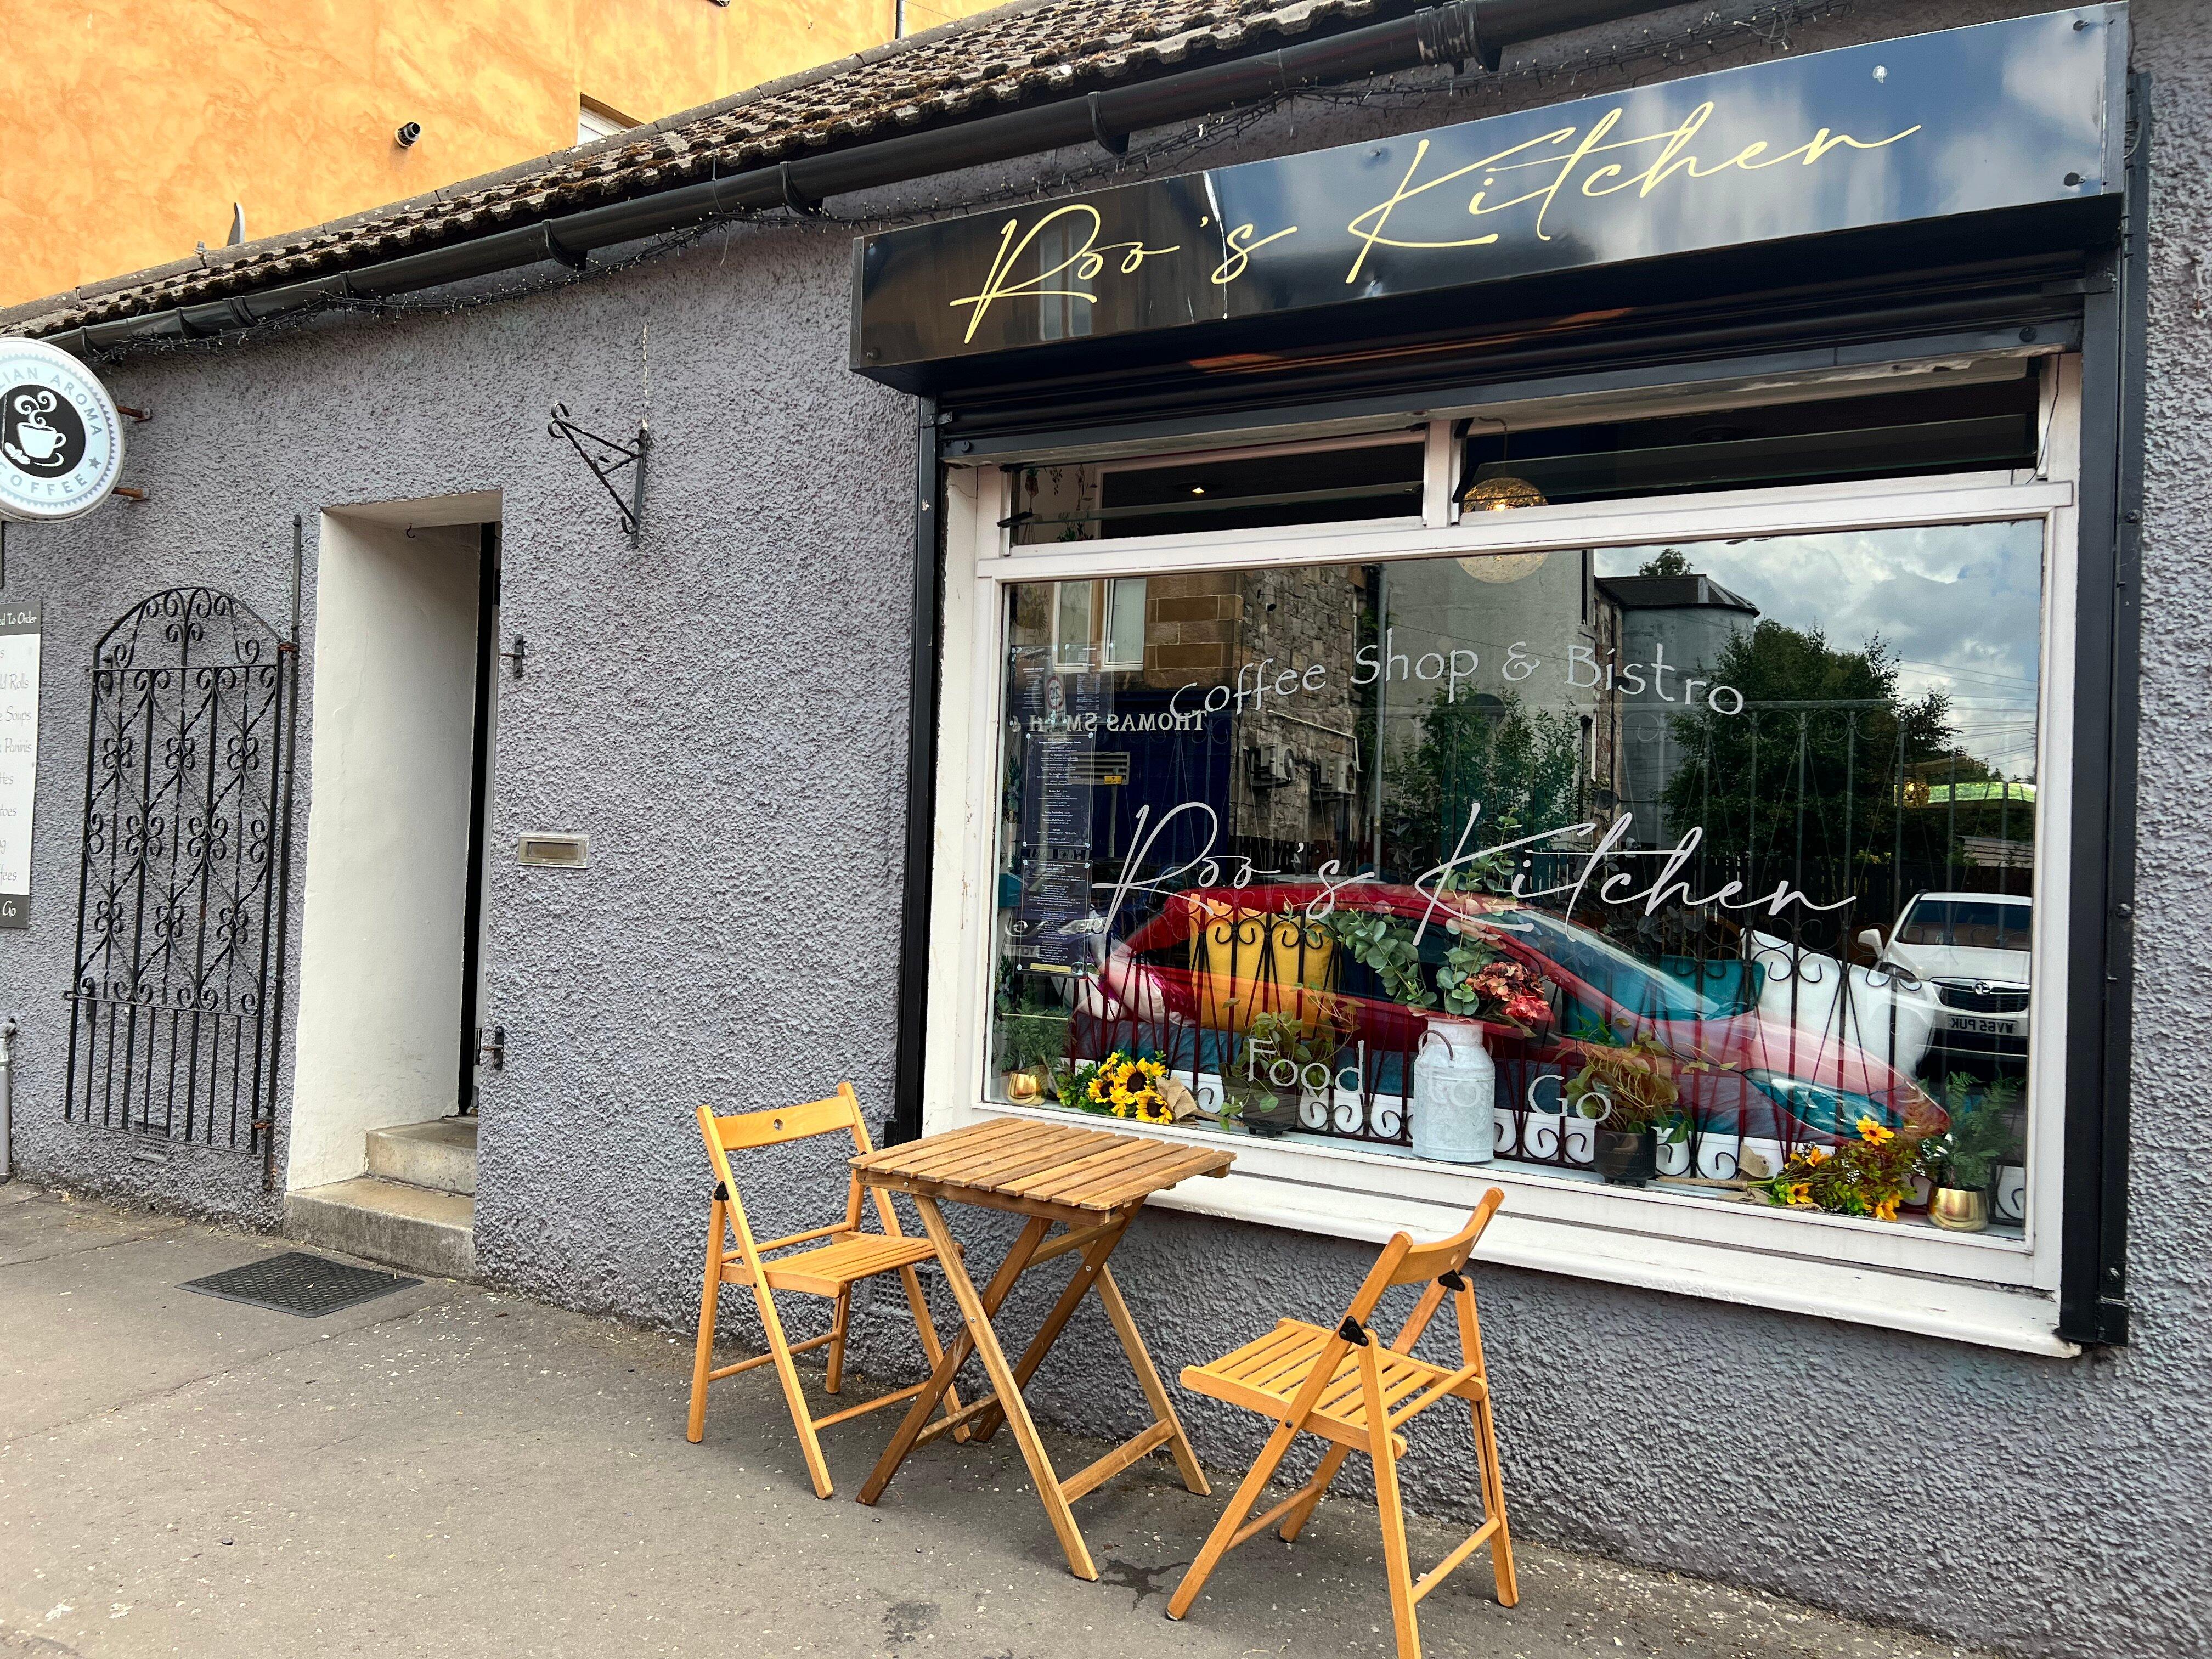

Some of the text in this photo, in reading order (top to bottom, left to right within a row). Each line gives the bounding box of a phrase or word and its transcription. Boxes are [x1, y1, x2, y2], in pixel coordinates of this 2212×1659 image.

[950, 101, 1921, 344] Roo's Kitchen
[50, 373, 103, 436] AROMA
[7, 613, 16, 625] To
[18, 611, 37, 624] Order
[9, 673, 29, 690] Rolls
[1170, 658, 1327, 720] Coffee
[1350, 628, 1479, 703] Shop
[1502, 641, 1540, 682] &
[1564, 643, 1744, 715] Bistro
[5, 706, 31, 726] Soups
[1092, 802, 1857, 946] Roo's Kitchen
[2, 900, 16, 917] Go
[1248, 1037, 1612, 1122] Food to Go
